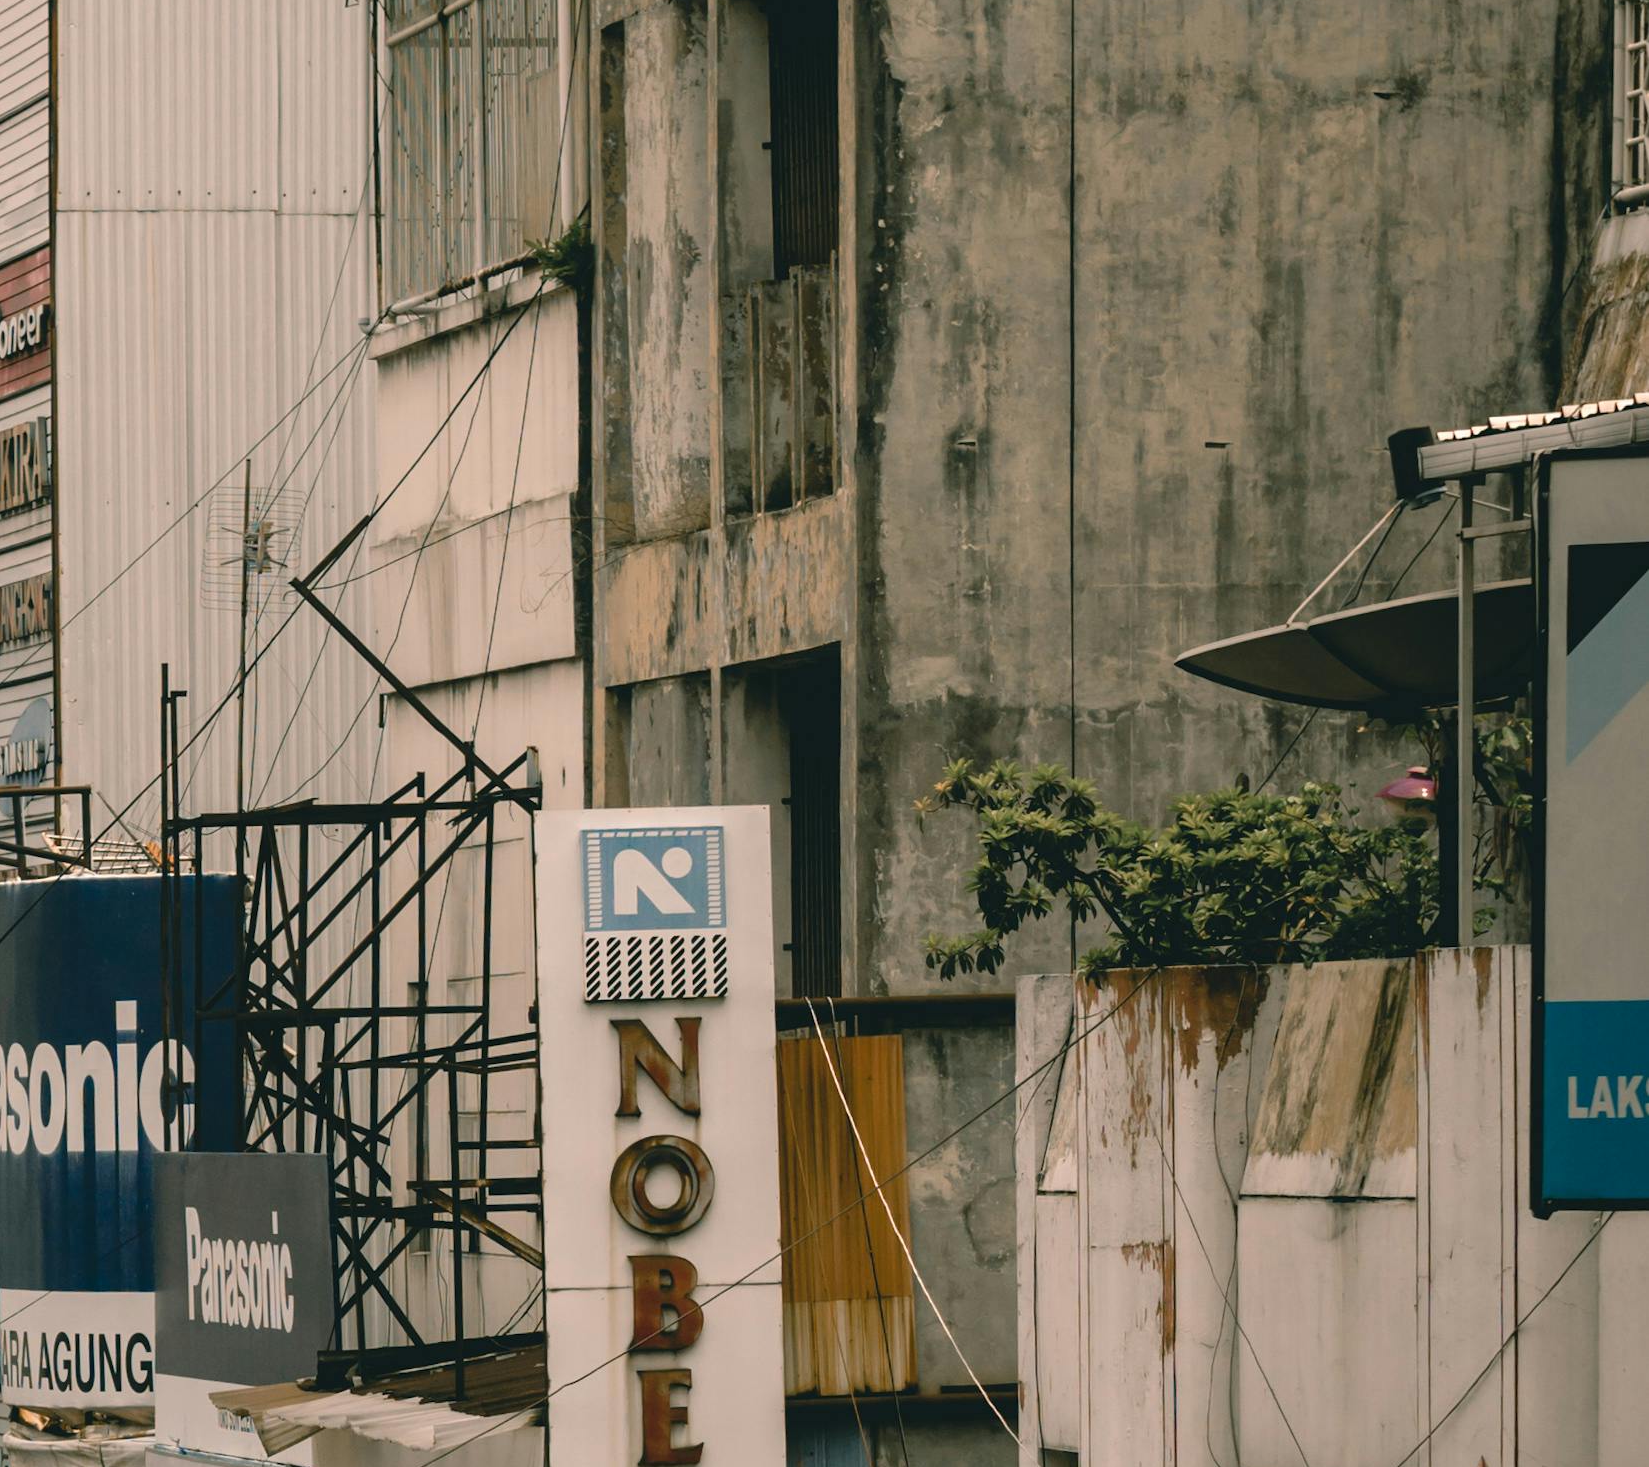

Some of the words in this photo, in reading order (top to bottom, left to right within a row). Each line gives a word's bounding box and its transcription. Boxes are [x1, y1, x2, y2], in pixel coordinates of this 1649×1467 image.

[1567, 1074, 1649, 1120] LAK
[184, 1206, 294, 1334] Panasonic
[38, 1331, 155, 1393] AGUNG
